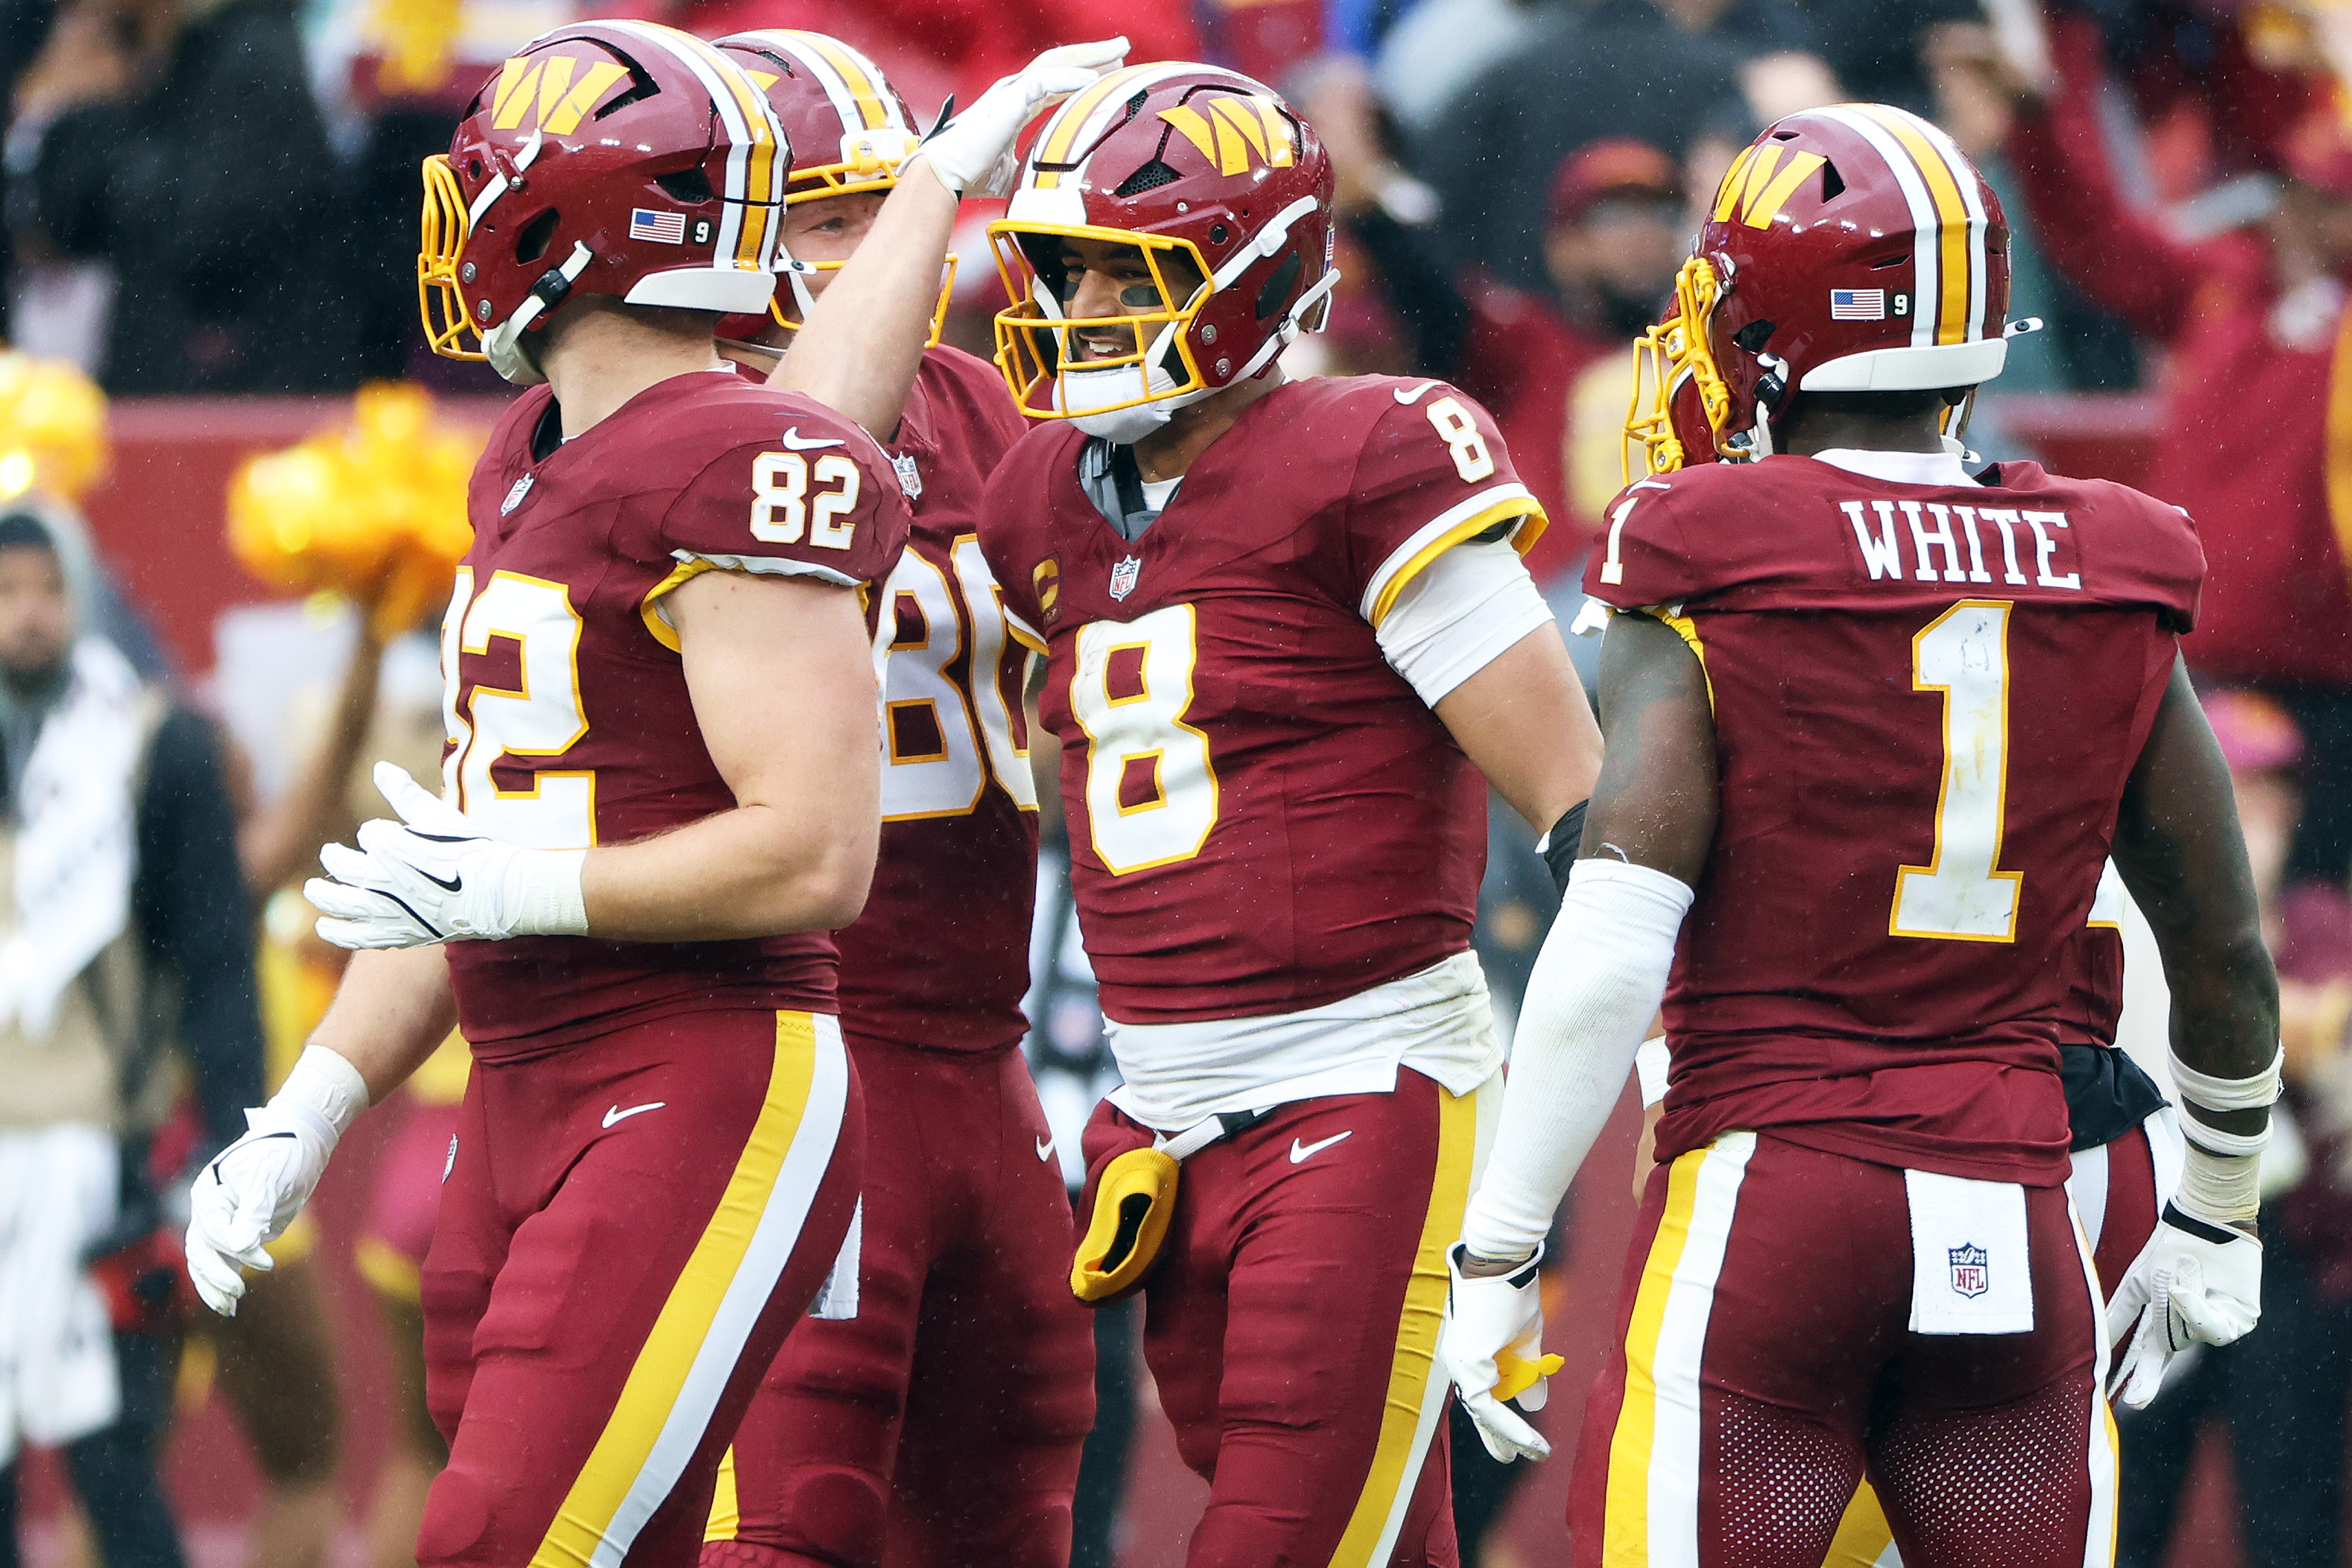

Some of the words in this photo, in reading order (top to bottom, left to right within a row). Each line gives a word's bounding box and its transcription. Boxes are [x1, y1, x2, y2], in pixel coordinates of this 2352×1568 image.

[695, 221, 709, 243] 9
[1895, 294, 1908, 315] 9
[902, 474, 919, 490] NFL
[1427, 396, 1495, 483] 8
[750, 451, 861, 550] 82
[1600, 497, 1640, 585] 1
[1114, 575, 1131, 592] NFL
[1839, 499, 2082, 590] WHITE
[1069, 602, 1219, 876] 8
[1889, 598, 2024, 943] 1
[1955, 1268, 1985, 1291] NFL
